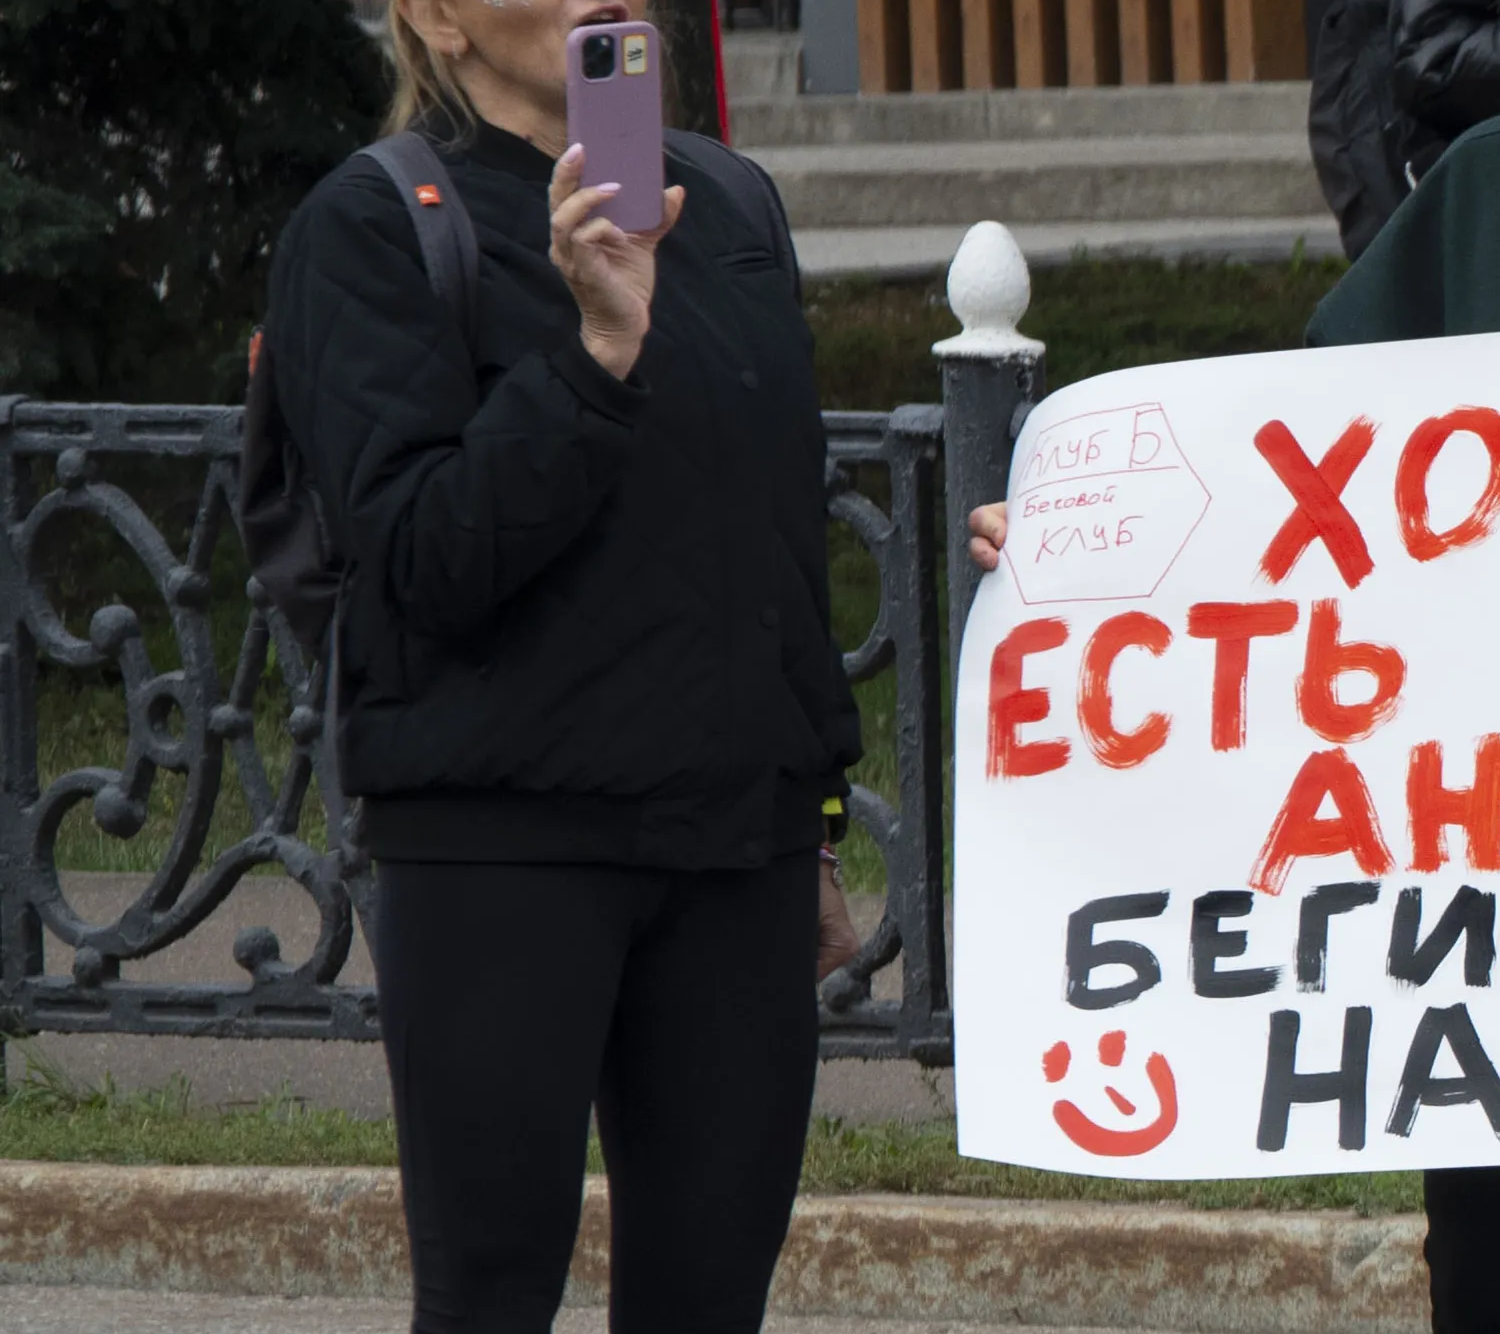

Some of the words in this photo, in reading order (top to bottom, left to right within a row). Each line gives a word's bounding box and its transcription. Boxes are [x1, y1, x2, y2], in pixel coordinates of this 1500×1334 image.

[1035, 516, 1144, 563] КЛУБ
[986, 598, 1407, 783] ЕСТЬ
[1067, 883, 1497, 1009] БЕГИ
